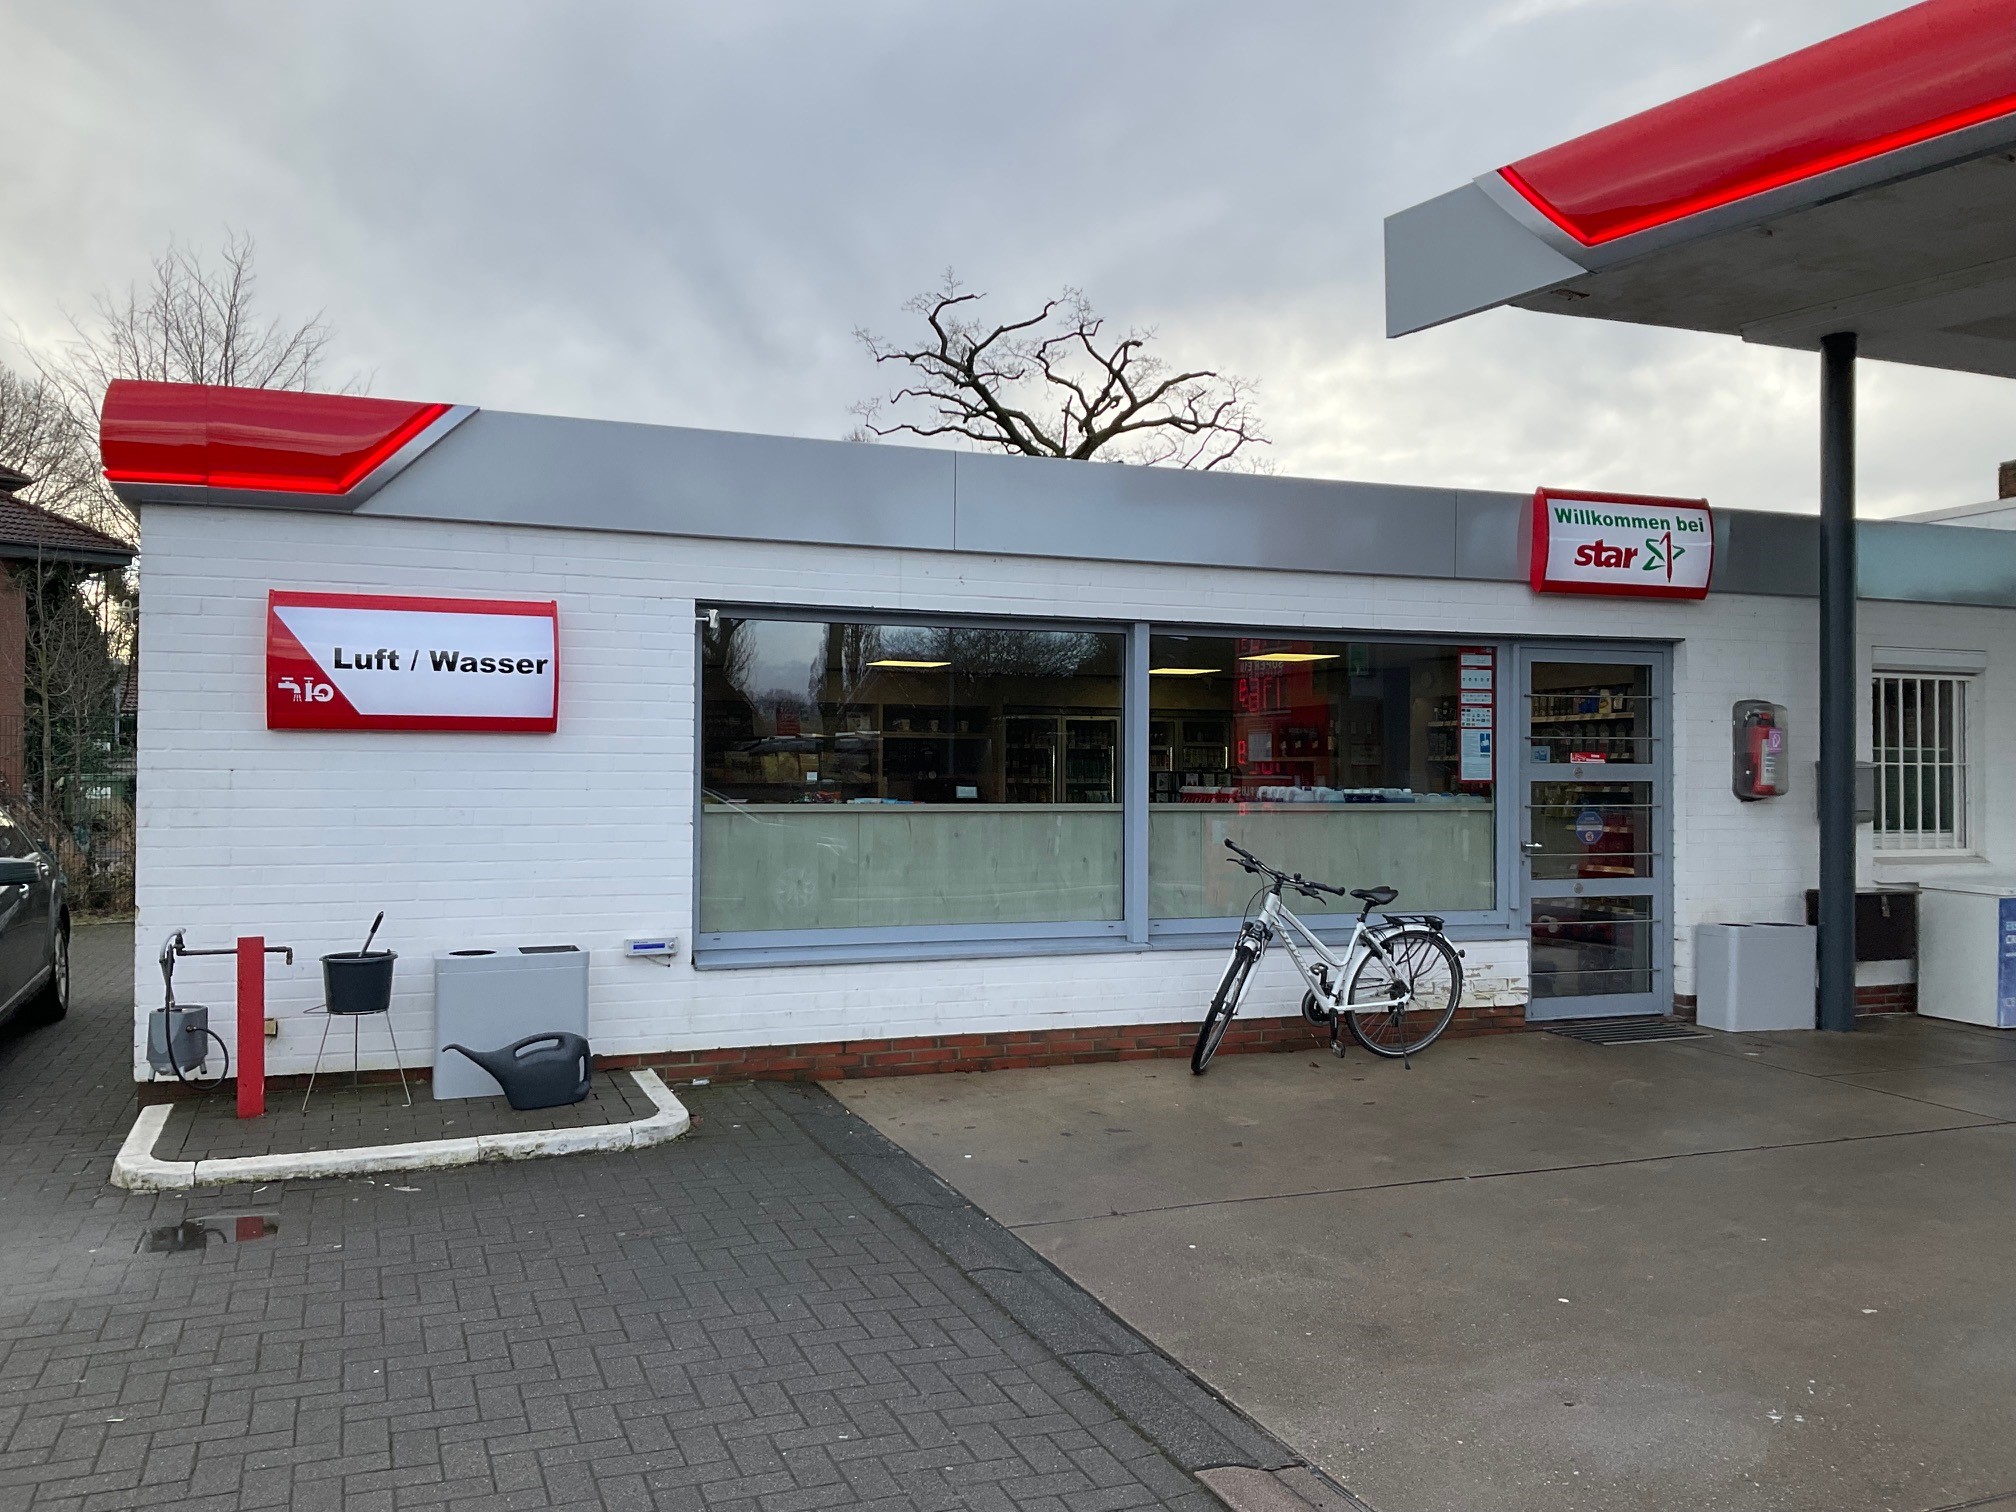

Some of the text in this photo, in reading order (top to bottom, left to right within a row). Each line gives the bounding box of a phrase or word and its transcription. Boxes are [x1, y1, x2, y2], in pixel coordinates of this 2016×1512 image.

[1554, 507, 1704, 532] Willkommen bei
[1574, 539, 1638, 569] star
[333, 647, 549, 675] Luft / Wasser
